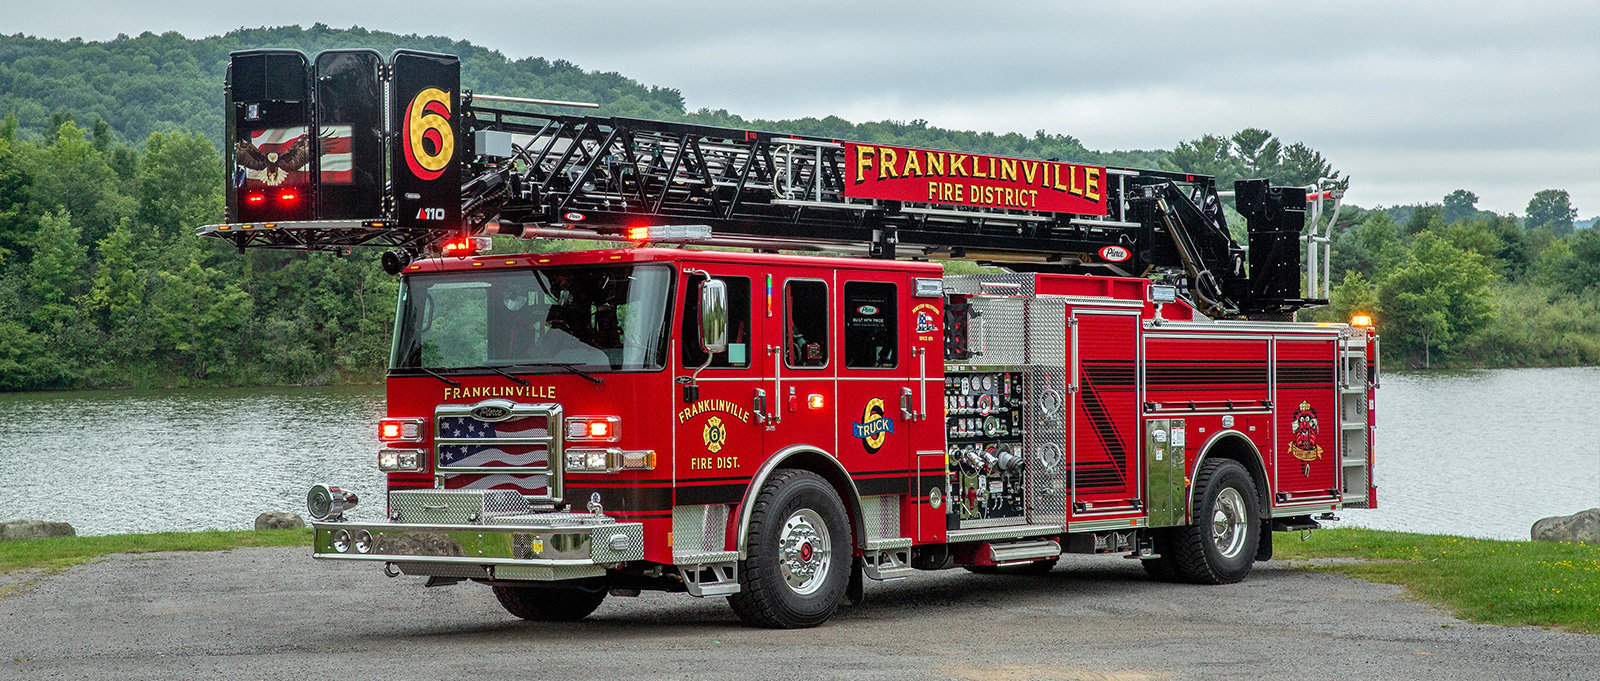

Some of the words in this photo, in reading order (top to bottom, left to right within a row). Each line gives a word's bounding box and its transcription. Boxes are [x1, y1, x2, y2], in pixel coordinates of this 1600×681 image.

[403, 87, 455, 181] 6
[854, 145, 1101, 203] FRANKLINVILLE
[928, 181, 964, 203] FIRE
[969, 184, 1038, 208] DISTRICT
[443, 386, 556, 401] FRANKLINVILLE
[678, 399, 750, 425] FRANKLINVILLE
[711, 428, 719, 442] 6
[856, 419, 890, 437] TRUCK
[862, 397, 885, 454] 6
[691, 457, 713, 470] FIRE
[716, 456, 741, 469] DIST.
